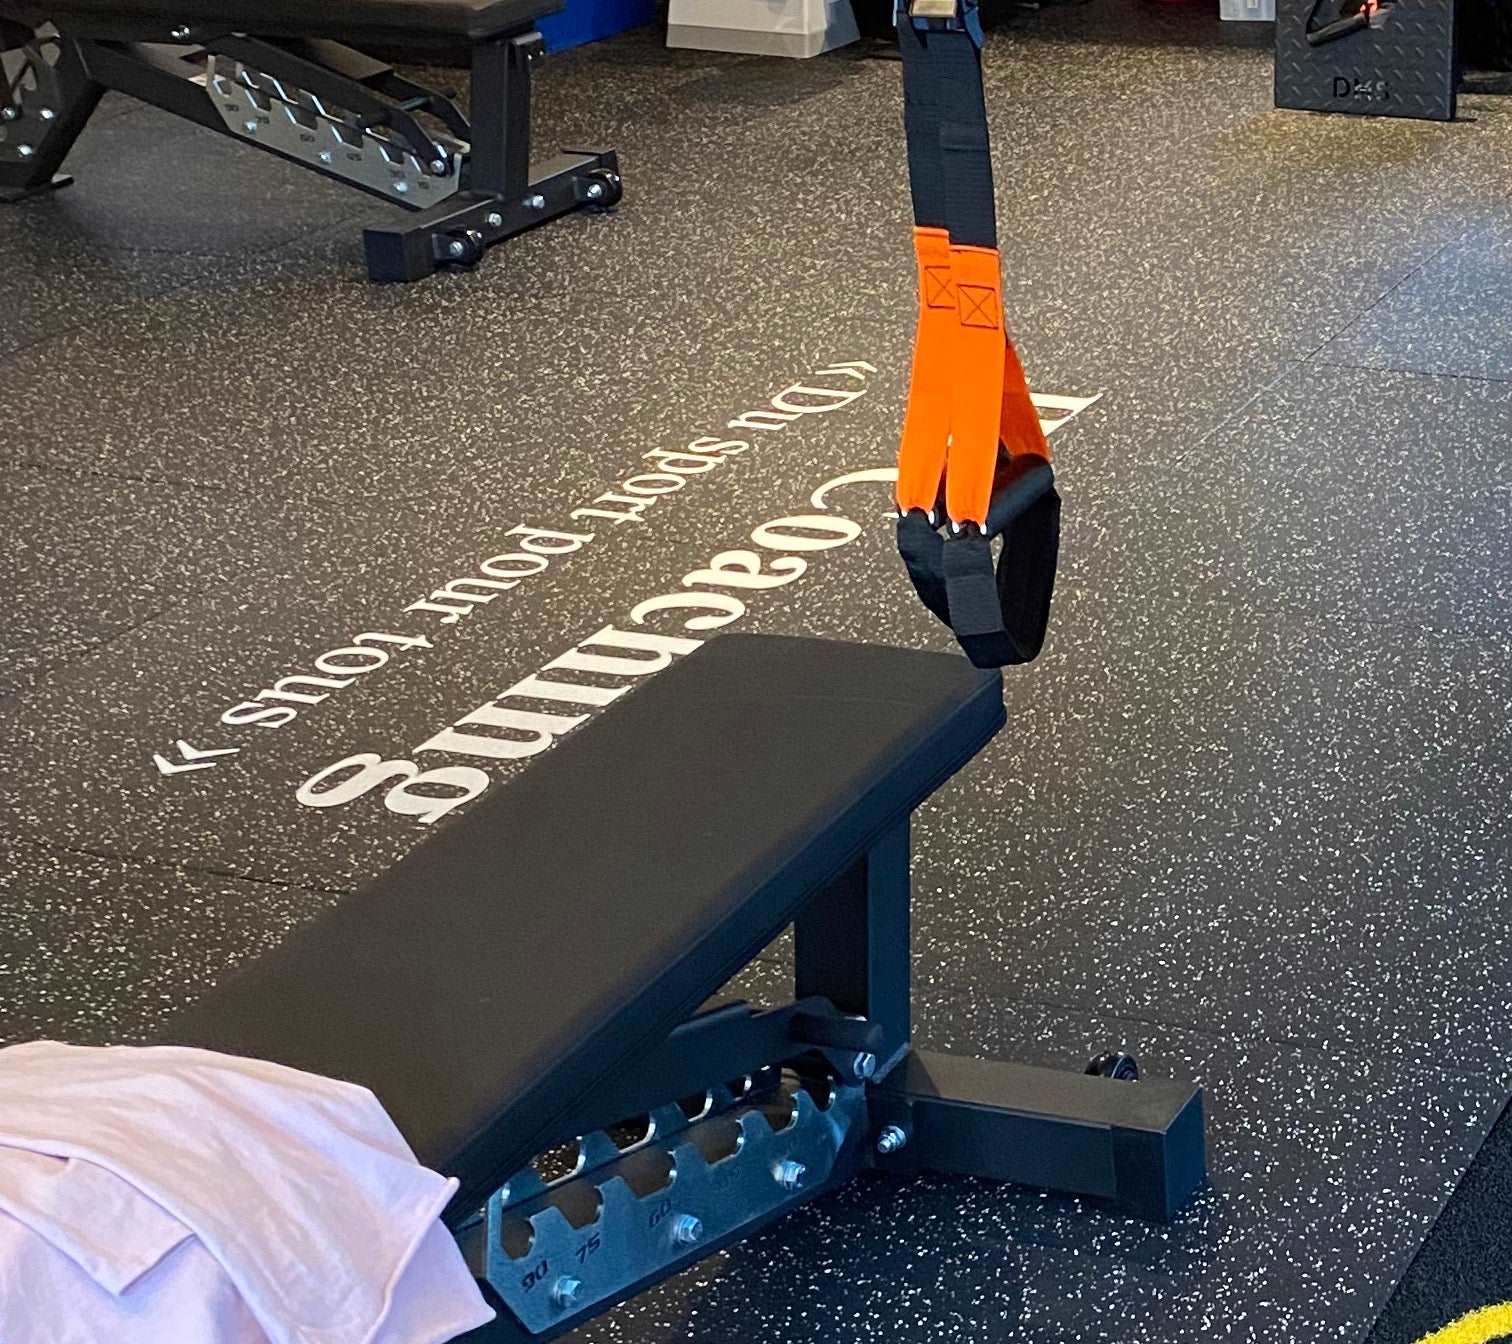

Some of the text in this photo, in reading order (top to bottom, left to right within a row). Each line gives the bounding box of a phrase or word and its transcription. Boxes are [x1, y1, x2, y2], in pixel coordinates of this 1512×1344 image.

[1333, 76, 1391, 102] DMS
[570, 437, 749, 525] sport
[403, 524, 595, 624] pour
[221, 632, 433, 728] tous
[522, 1200, 672, 1293] 90 75 60
